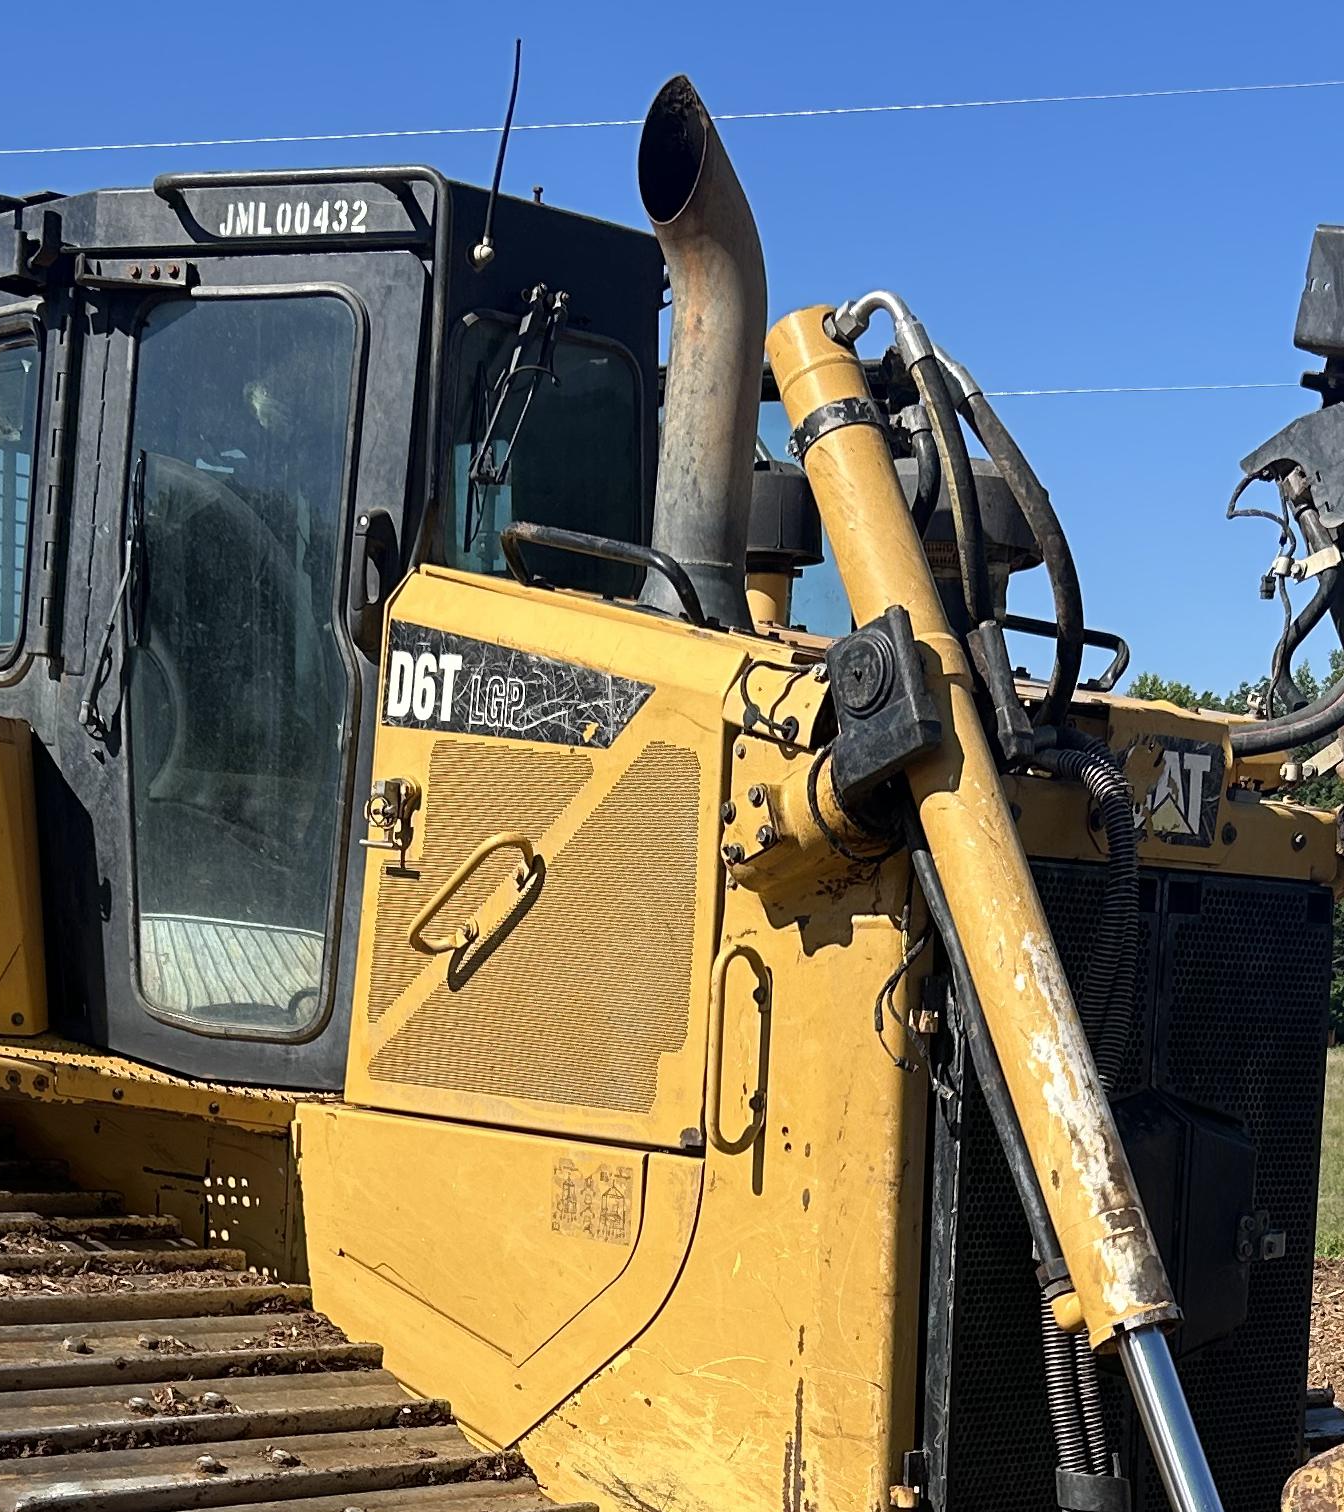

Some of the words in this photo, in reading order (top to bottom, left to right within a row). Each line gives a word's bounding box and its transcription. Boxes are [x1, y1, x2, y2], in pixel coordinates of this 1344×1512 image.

[219, 200, 368, 236] JML00432
[387, 650, 463, 722] D6T
[468, 674, 526, 728] LGP
[1132, 750, 1212, 836] AT
